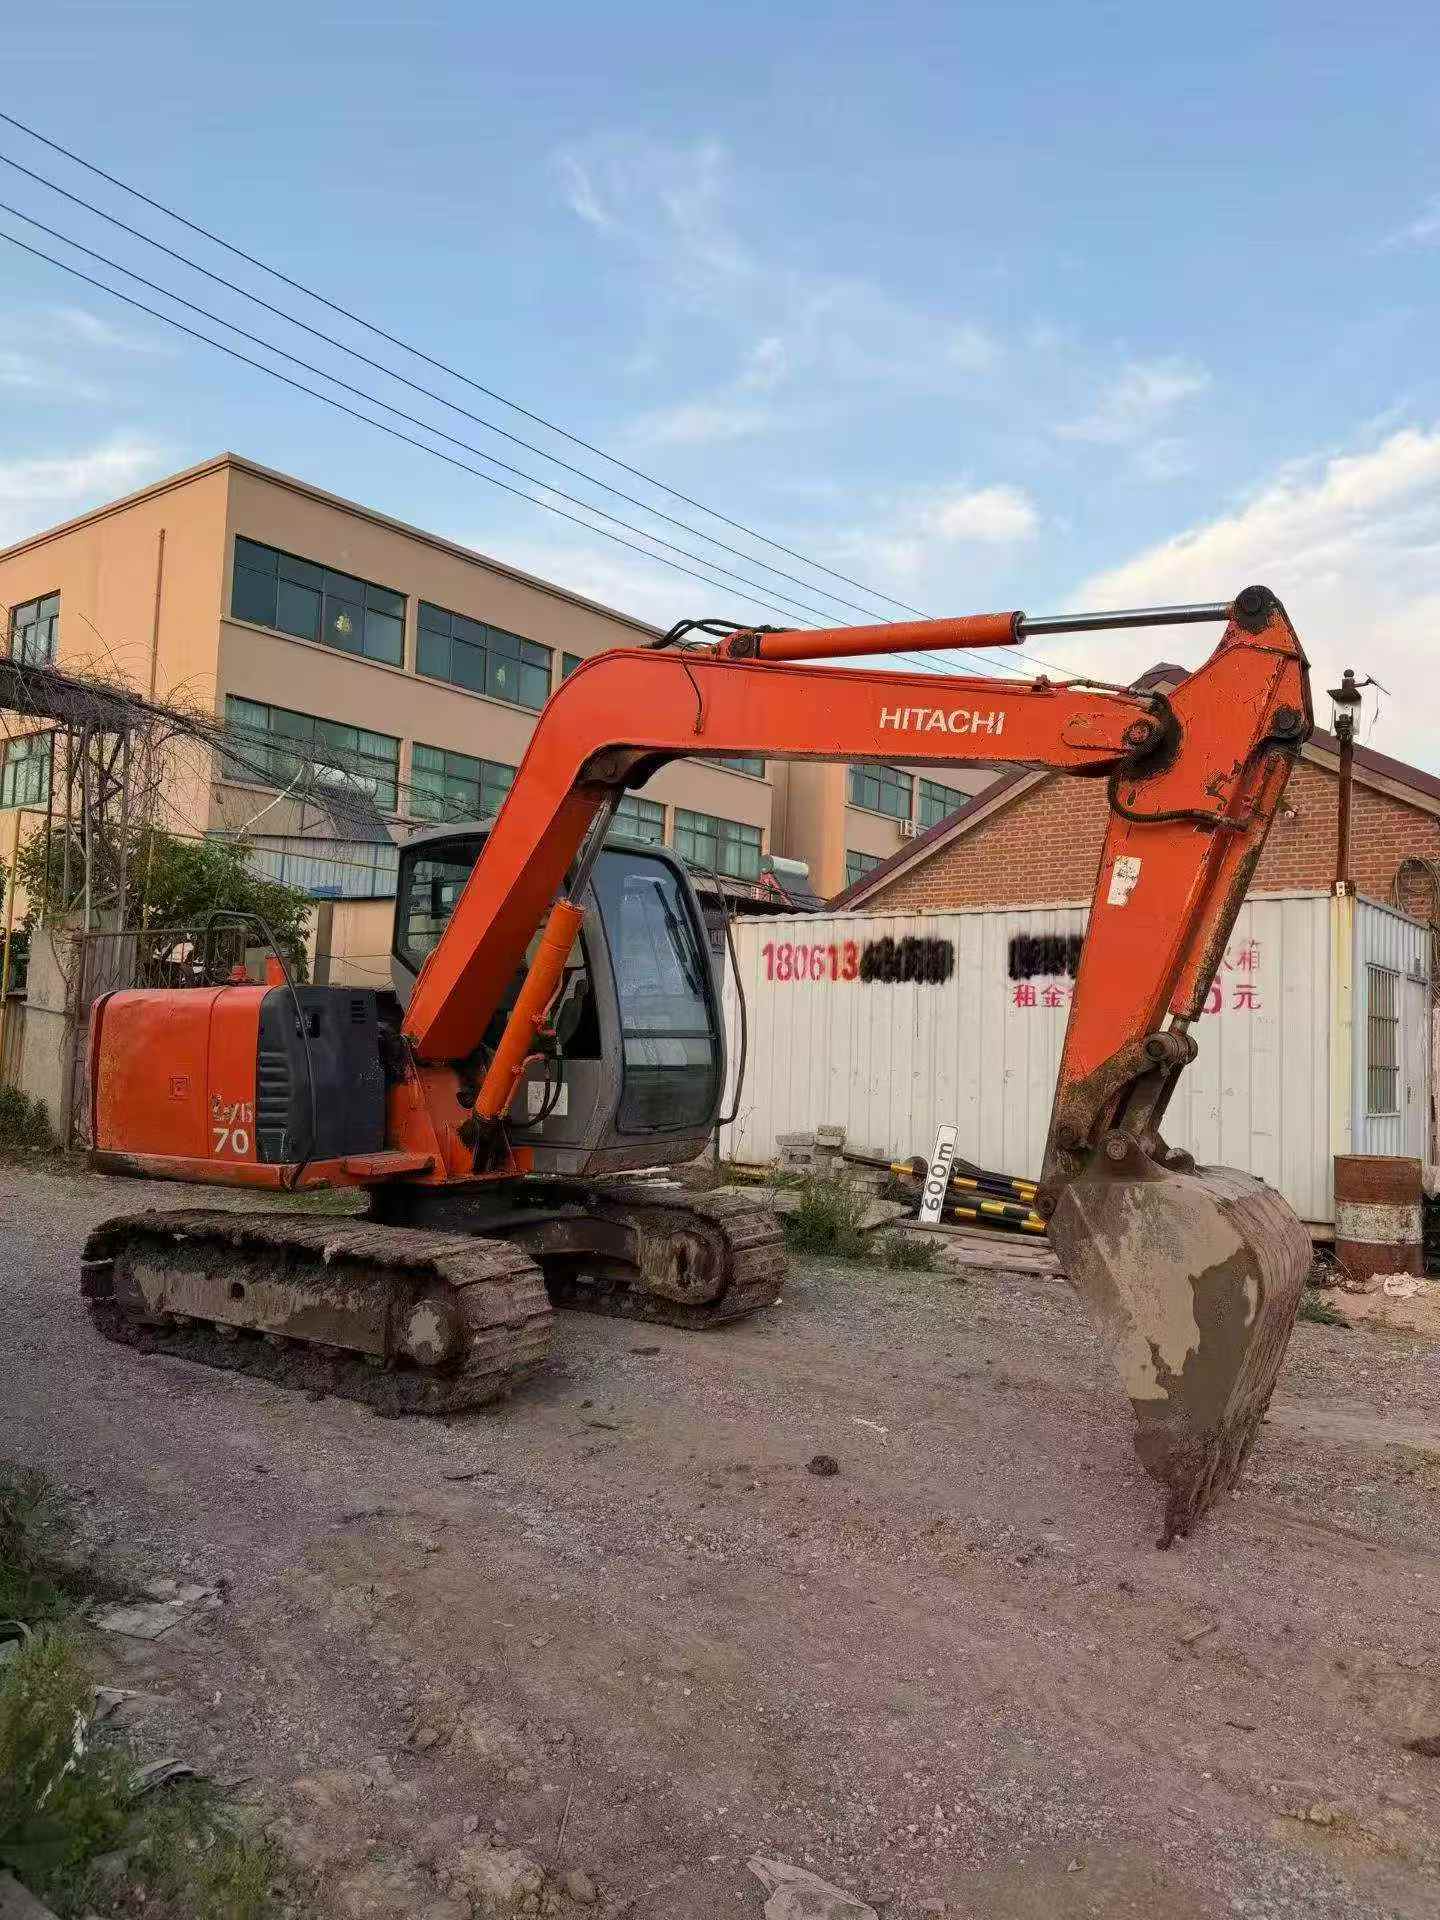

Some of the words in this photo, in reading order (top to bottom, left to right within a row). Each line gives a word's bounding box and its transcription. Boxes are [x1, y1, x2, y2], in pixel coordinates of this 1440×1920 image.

[880, 707, 1006, 735] HITACHI
[1012, 984, 1074, 1008] 租金
[212, 1127, 250, 1154] 70
[924, 1142, 954, 1211] 600m
